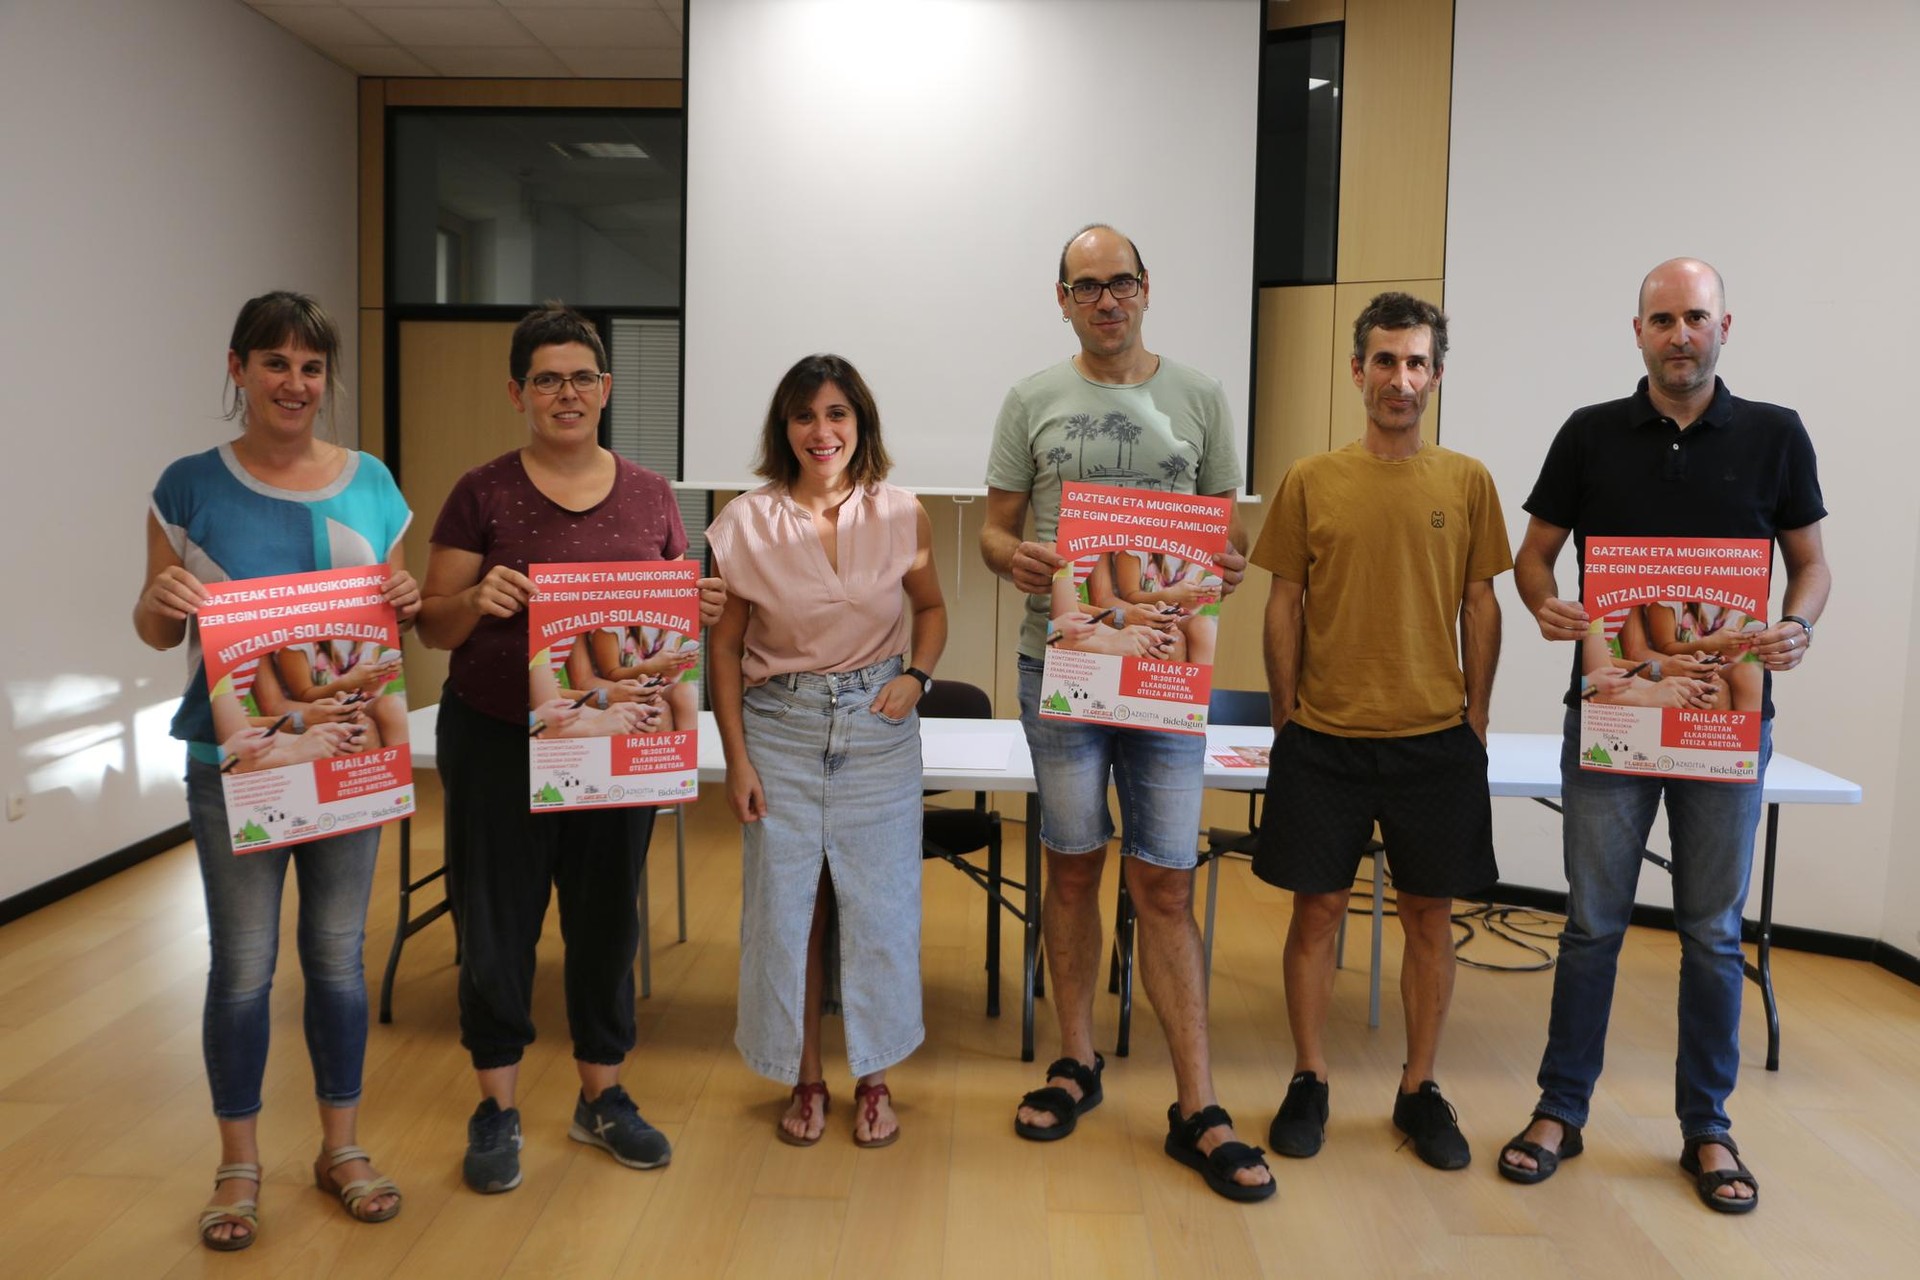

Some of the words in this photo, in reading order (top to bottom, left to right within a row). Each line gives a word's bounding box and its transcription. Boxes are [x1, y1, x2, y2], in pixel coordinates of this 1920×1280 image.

[1068, 491, 1120, 506] GAZTEAK
[1122, 497, 1144, 508] ETA
[1146, 500, 1224, 517] MUGIKORRAK:
[1060, 508, 1081, 518] ZER
[1082, 511, 1108, 522] EGIN
[1110, 514, 1168, 528] DEZAKEGU
[1170, 519, 1227, 535] FAMILIOK?
[1068, 533, 1214, 567] HITZALDI-SOLASALDIA
[1591, 546, 1647, 557] GAZTEAK
[1650, 547, 1674, 557] ETA
[1677, 547, 1763, 559] MUGIKORRAK:
[535, 573, 590, 584] GAZTEAK
[592, 572, 614, 583] ETA
[617, 570, 694, 582] MUGIKORRAK:
[1585, 563, 1607, 574] ZER
[1609, 564, 1636, 574] EGIN
[1638, 564, 1701, 575] DEZAKEGU
[1704, 566, 1767, 577] FAMILIOK?
[204, 589, 267, 606] GAZTEAK
[269, 582, 295, 599] ETA
[529, 592, 551, 602] ZER
[553, 591, 580, 602] EGIN
[582, 589, 641, 600] DEZAKEGU
[643, 587, 699, 599] FAMILIOK?
[1596, 584, 1757, 612] HITZALDI-SOLASALDIA
[200, 614, 226, 627] ZER
[227, 610, 257, 623] EGIN
[260, 602, 327, 620] DEZAKEGU
[541, 609, 691, 638] HITZALDI-SOLASALDIA
[218, 622, 388, 664] HITZALDI-SOLASALDIA
[1137, 661, 1182, 675] IRAILAK
[1185, 666, 1199, 677] 27
[1137, 688, 1160, 696] OTEIZA
[1162, 691, 1194, 700] ARETOAN
[1162, 716, 1203, 729] Bidelagun
[1679, 712, 1727, 724] IRAILAK
[1731, 714, 1746, 725] 27
[1693, 724, 1732, 732] 18:30ETAN
[626, 735, 671, 748] IRAILAK
[674, 734, 687, 745] 27
[1707, 740, 1742, 748] ARETOAN
[331, 753, 381, 772] IRAILAK
[383, 750, 398, 761] 27
[1710, 765, 1754, 776] Bidelagun
[658, 787, 695, 797] Bidelagun
